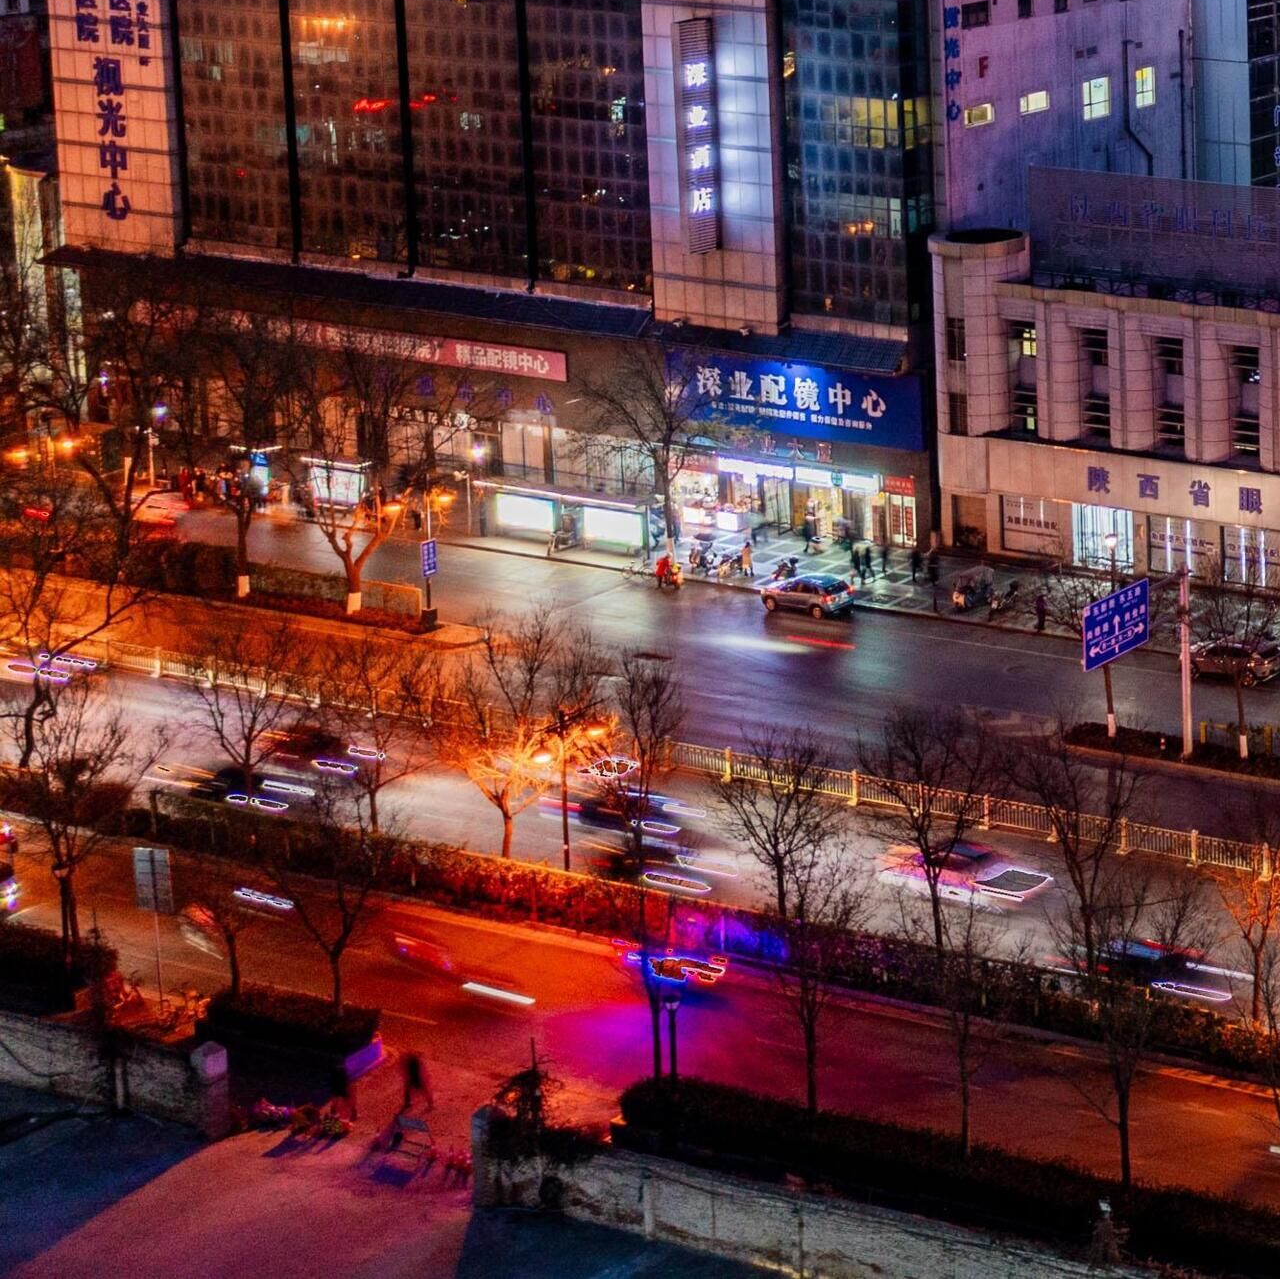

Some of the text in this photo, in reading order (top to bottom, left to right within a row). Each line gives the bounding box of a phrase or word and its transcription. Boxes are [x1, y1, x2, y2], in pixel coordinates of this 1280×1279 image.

[93, 57, 131, 221] 视光中心
[455, 343, 550, 374] 精品配镜中心
[697, 365, 887, 419] 深业配镜中心
